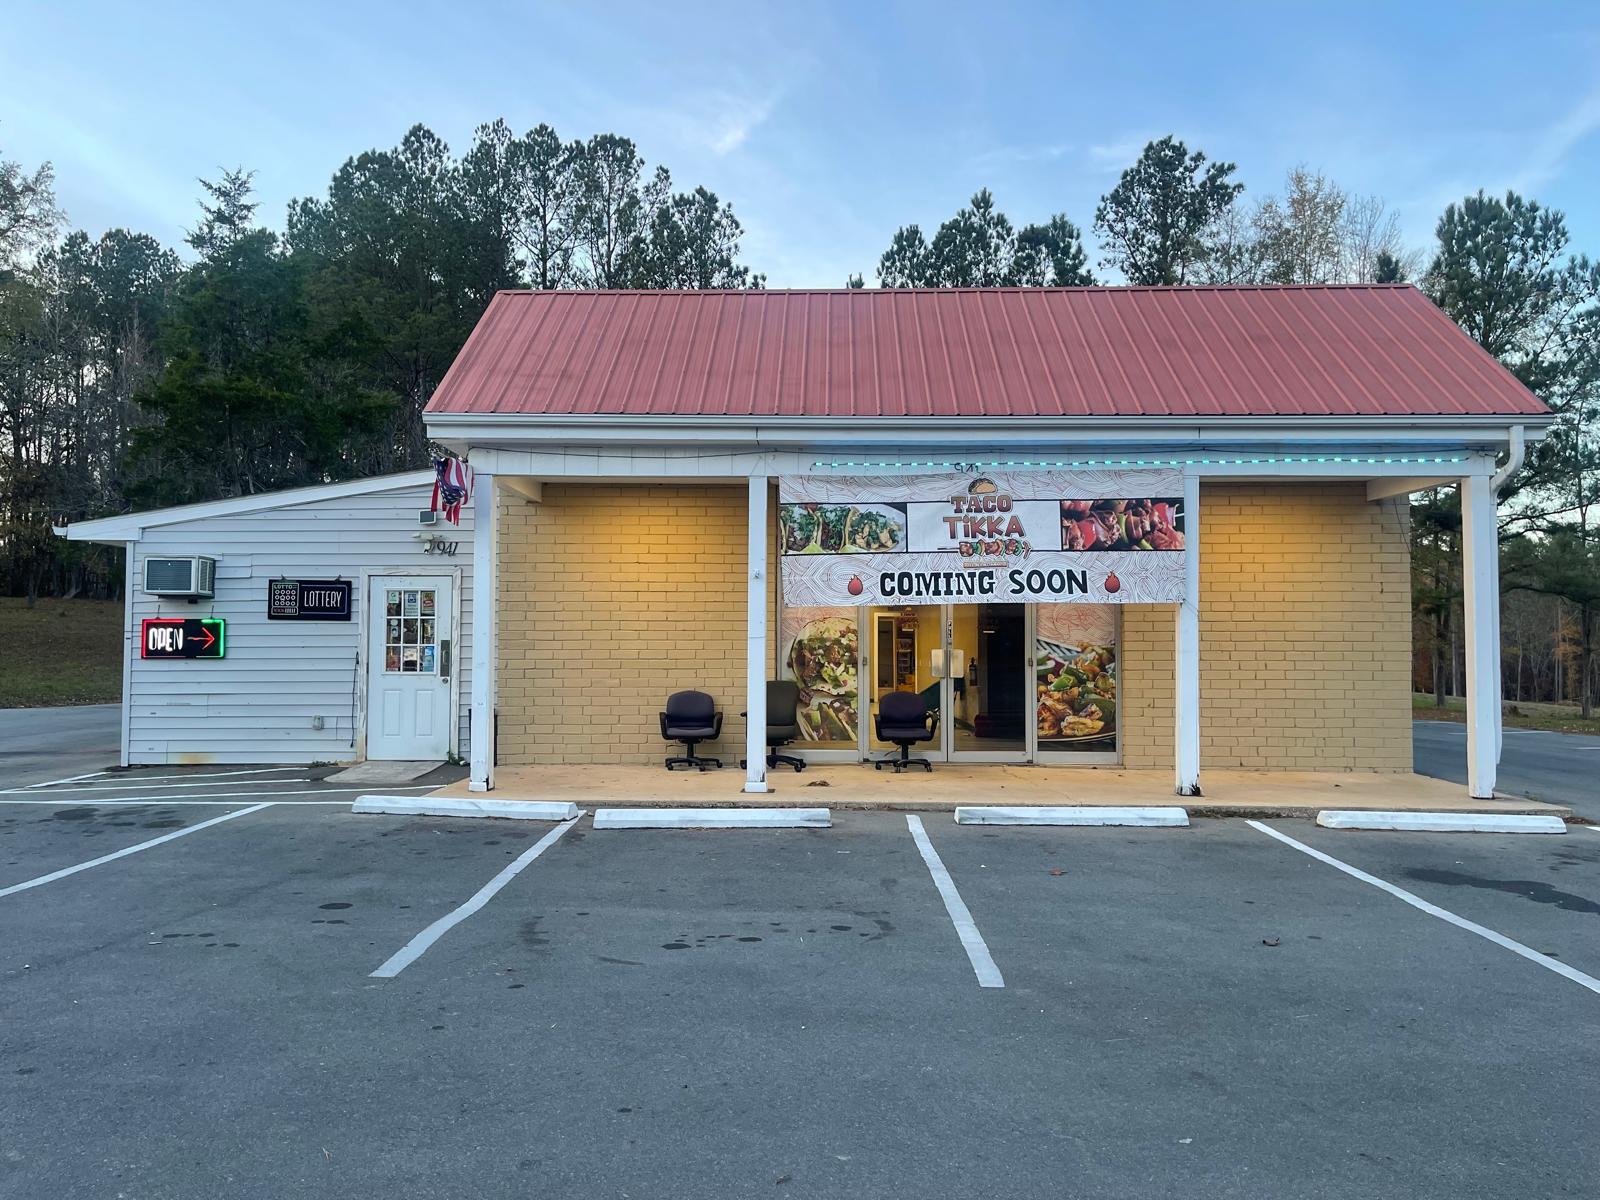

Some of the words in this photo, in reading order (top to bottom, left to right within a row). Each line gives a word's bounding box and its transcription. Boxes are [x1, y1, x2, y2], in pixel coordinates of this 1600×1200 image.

[951, 495, 1012, 513] TACO
[879, 569, 996, 597] COMING
[1009, 568, 1089, 595] SOON
[304, 590, 342, 607] LOTTERY
[148, 627, 184, 651] OPEN
